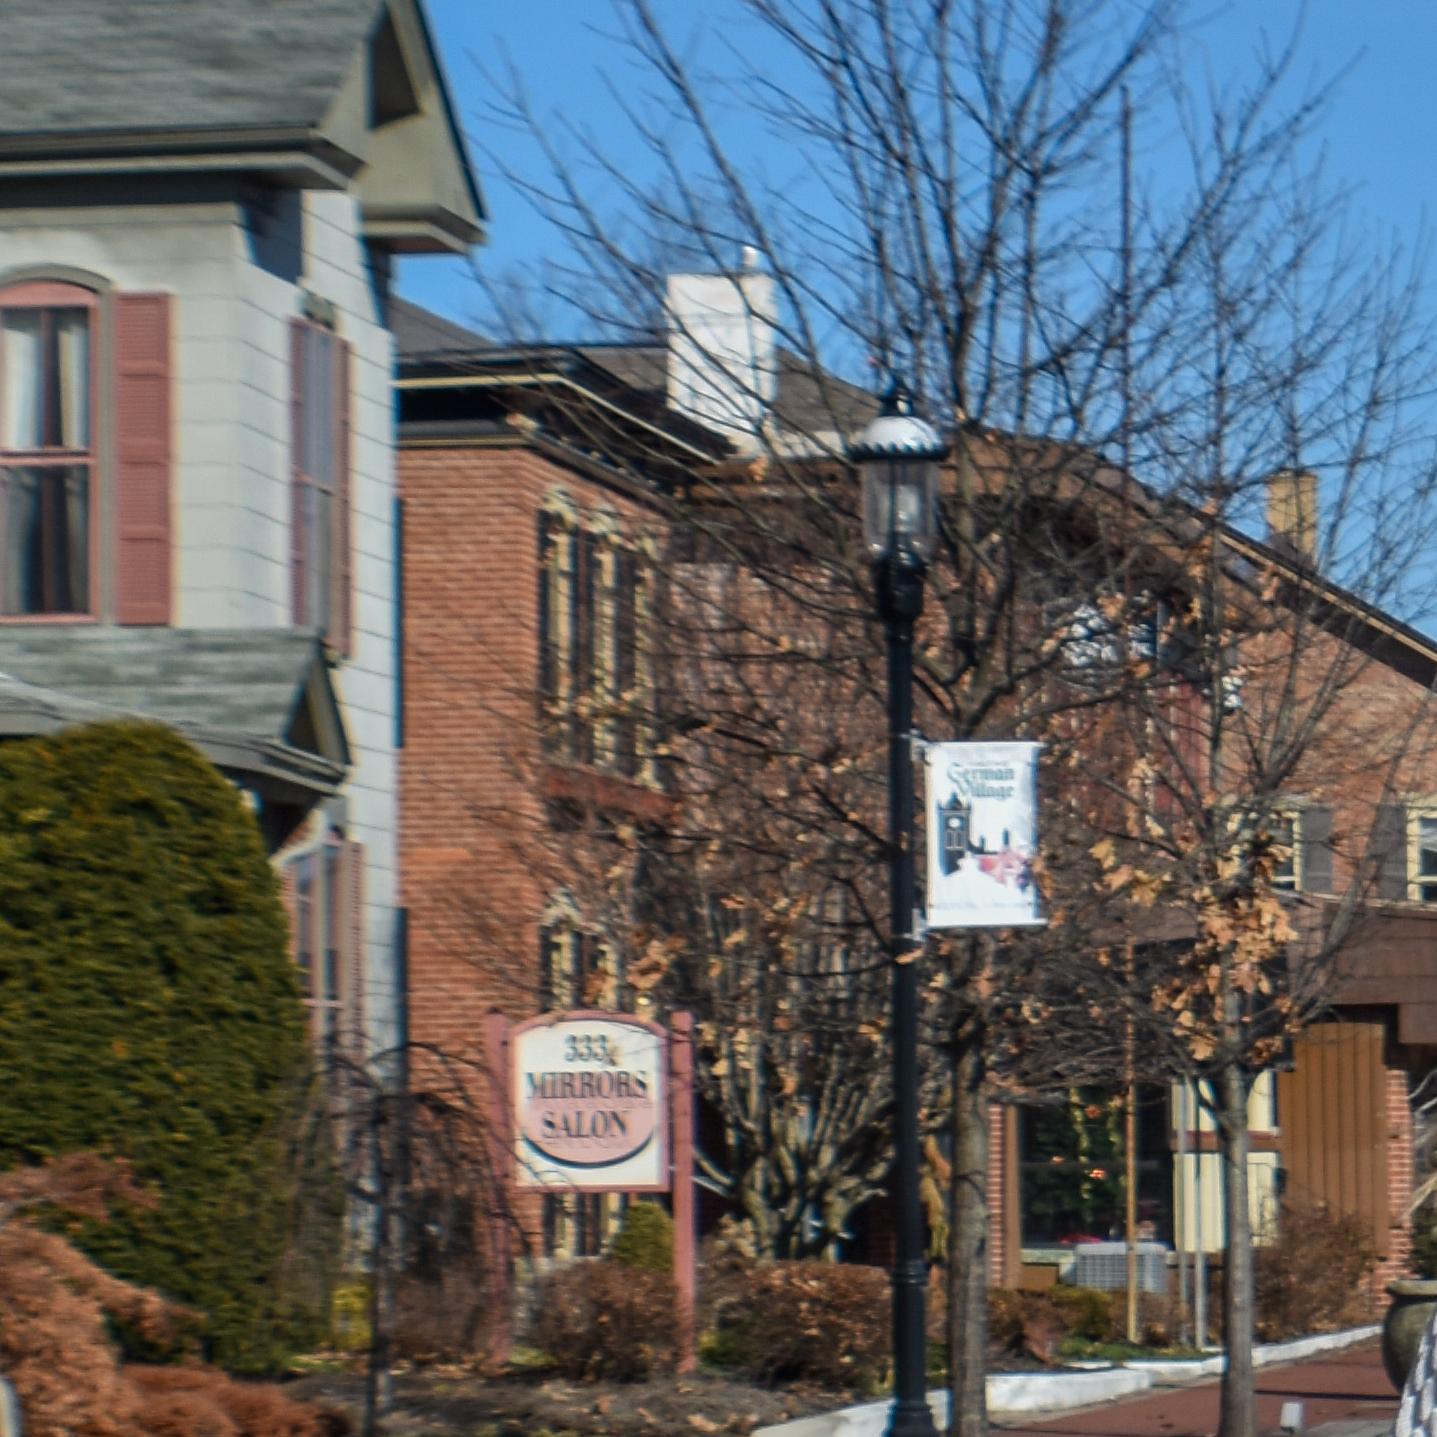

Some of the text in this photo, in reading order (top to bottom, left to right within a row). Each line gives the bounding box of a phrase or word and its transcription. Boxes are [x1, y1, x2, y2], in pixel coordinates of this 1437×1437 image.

[565, 1034, 608, 1062] 333
[526, 1070, 648, 1099] MIRRORS
[542, 1110, 630, 1138] SALON
